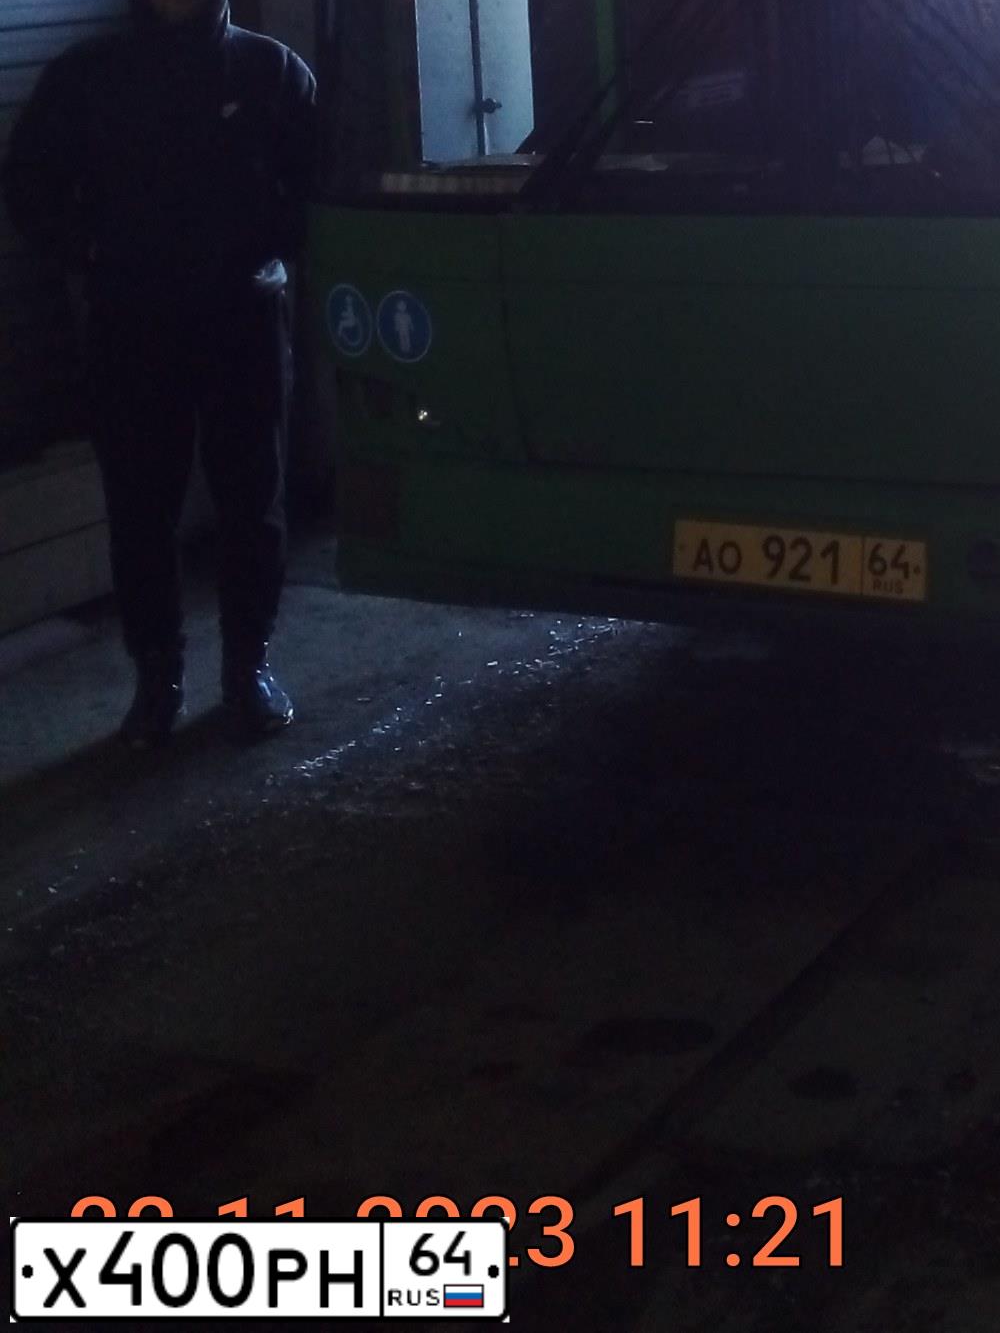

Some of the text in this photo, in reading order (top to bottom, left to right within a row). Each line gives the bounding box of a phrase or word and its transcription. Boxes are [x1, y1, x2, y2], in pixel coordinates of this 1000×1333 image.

[762, 535, 840, 585] 921
[868, 542, 909, 579] 64
[872, 581, 904, 595] RUS
